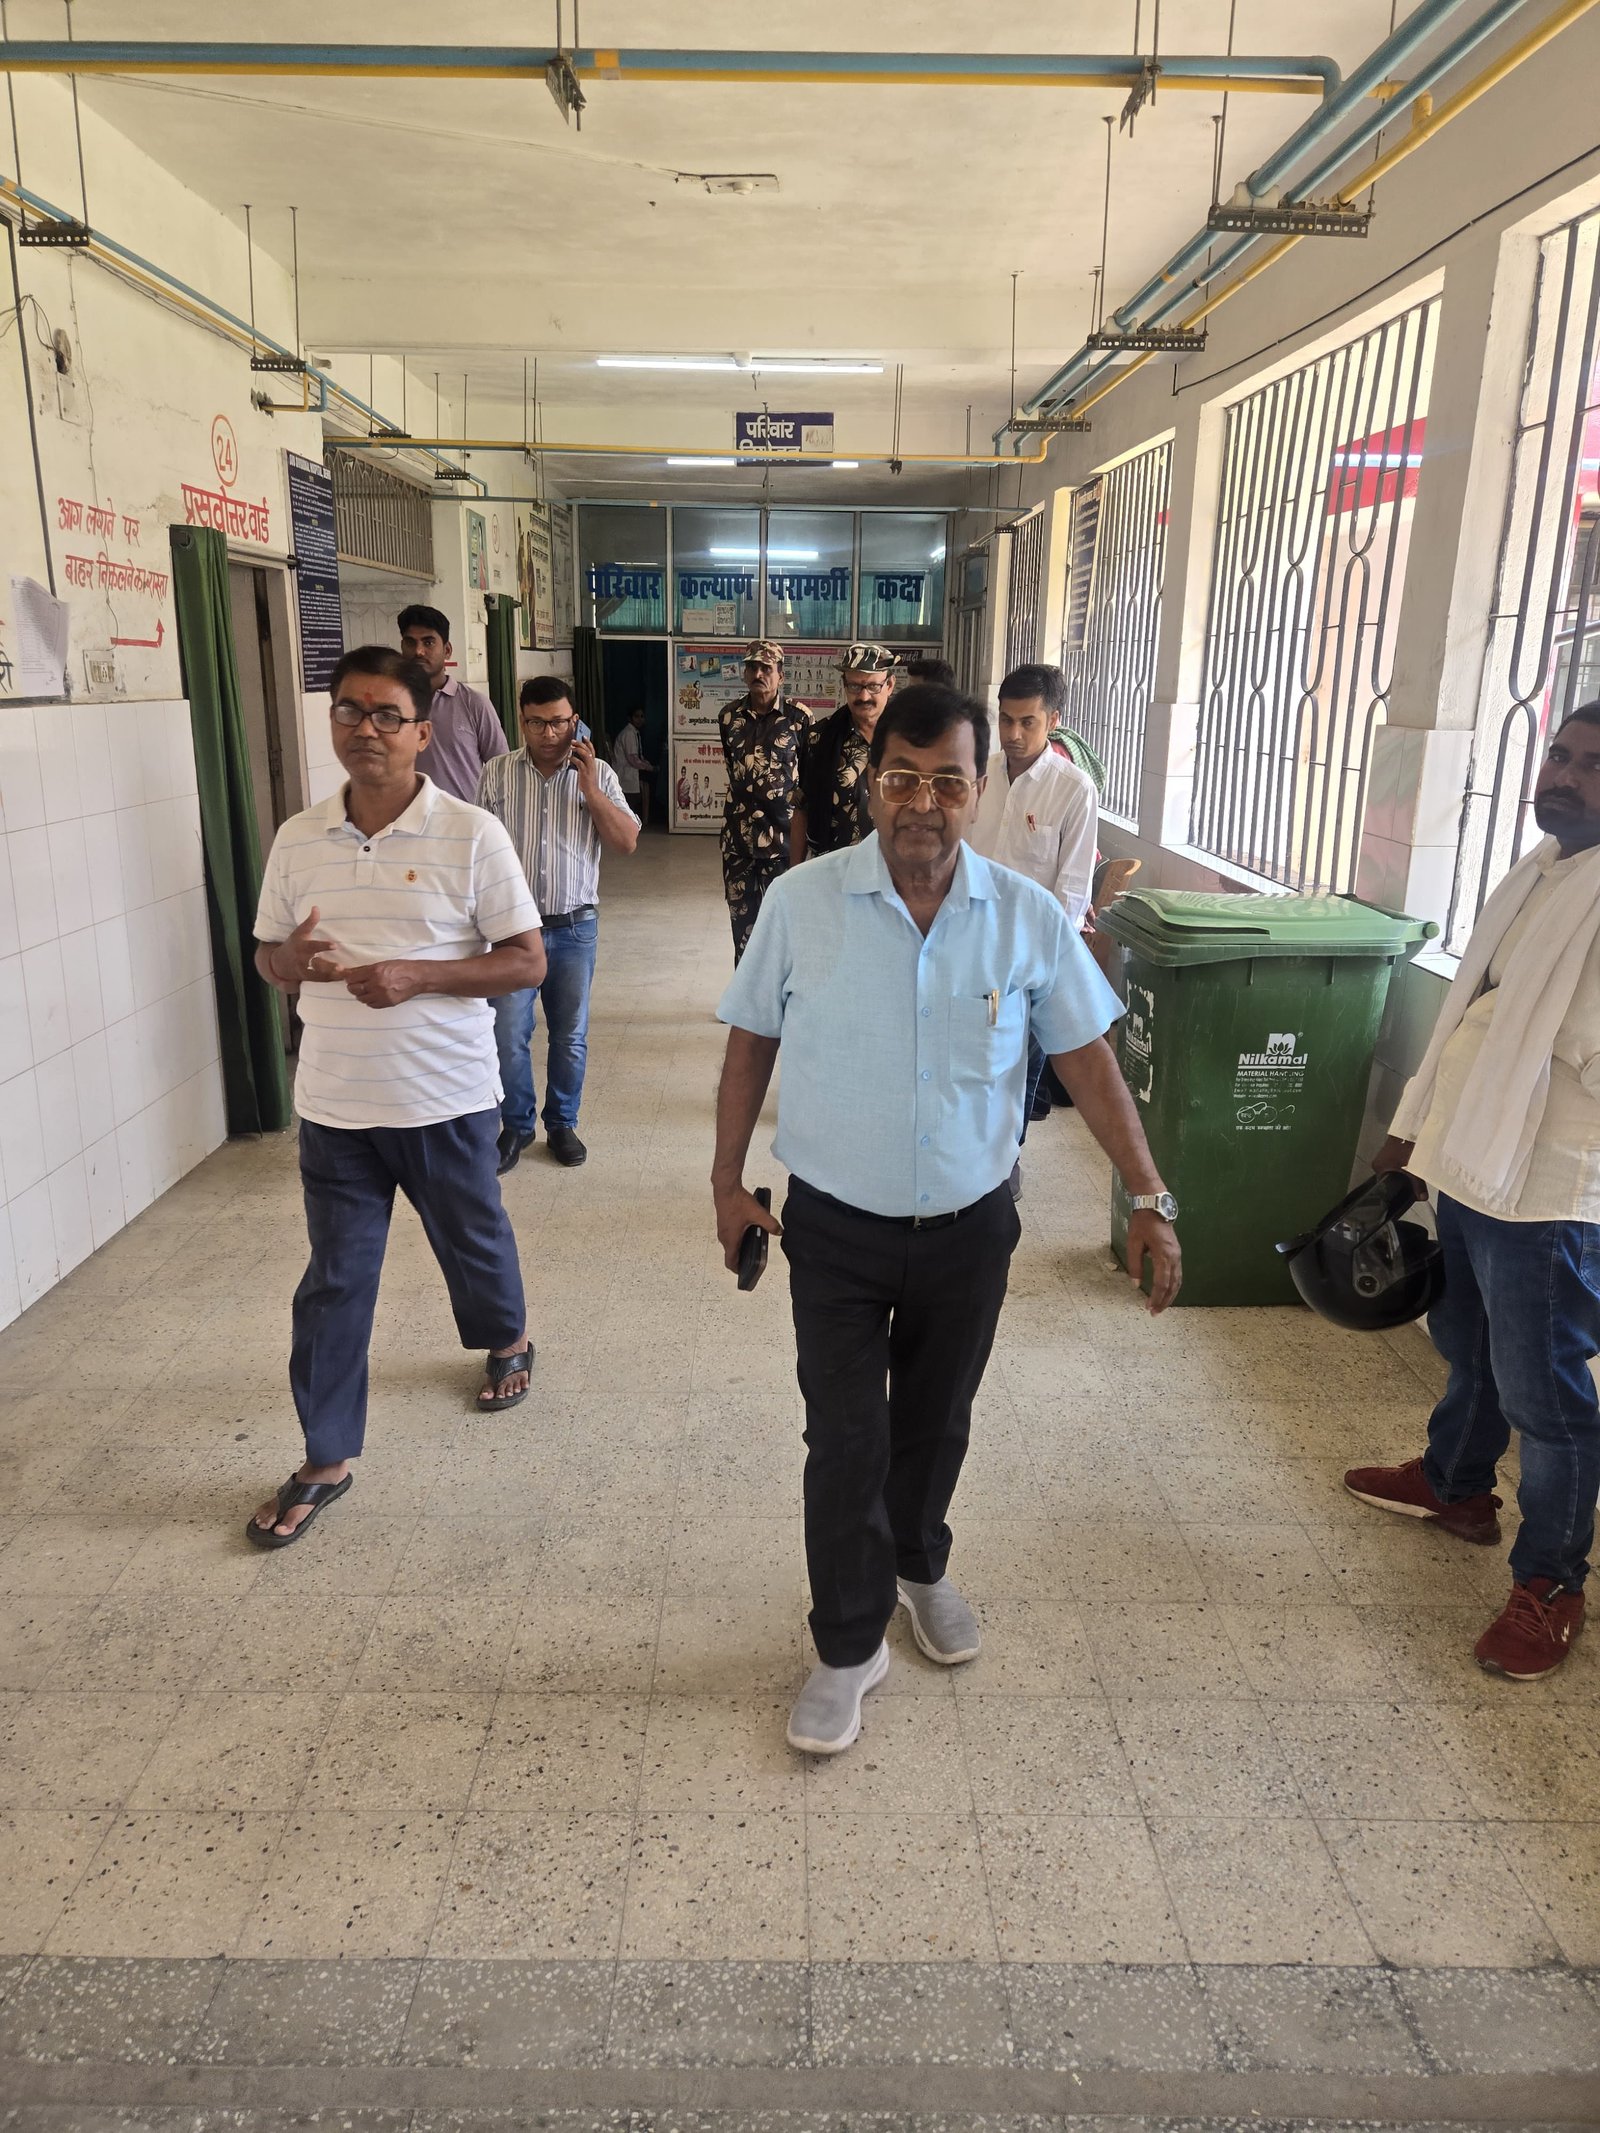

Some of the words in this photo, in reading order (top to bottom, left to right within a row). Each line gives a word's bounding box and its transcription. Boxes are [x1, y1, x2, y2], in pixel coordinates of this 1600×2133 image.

[216, 435, 233, 472] 24
[58, 498, 84, 531] आग
[122, 515, 141, 548] पर
[248, 496, 270, 544] वार्ड
[65, 554, 94, 591] बाहर
[585, 562, 663, 600] परिवार
[678, 572, 755, 601] कल्याण
[874, 574, 925, 603] कक्ष
[1238, 1053, 1309, 1065] Nilkamal
